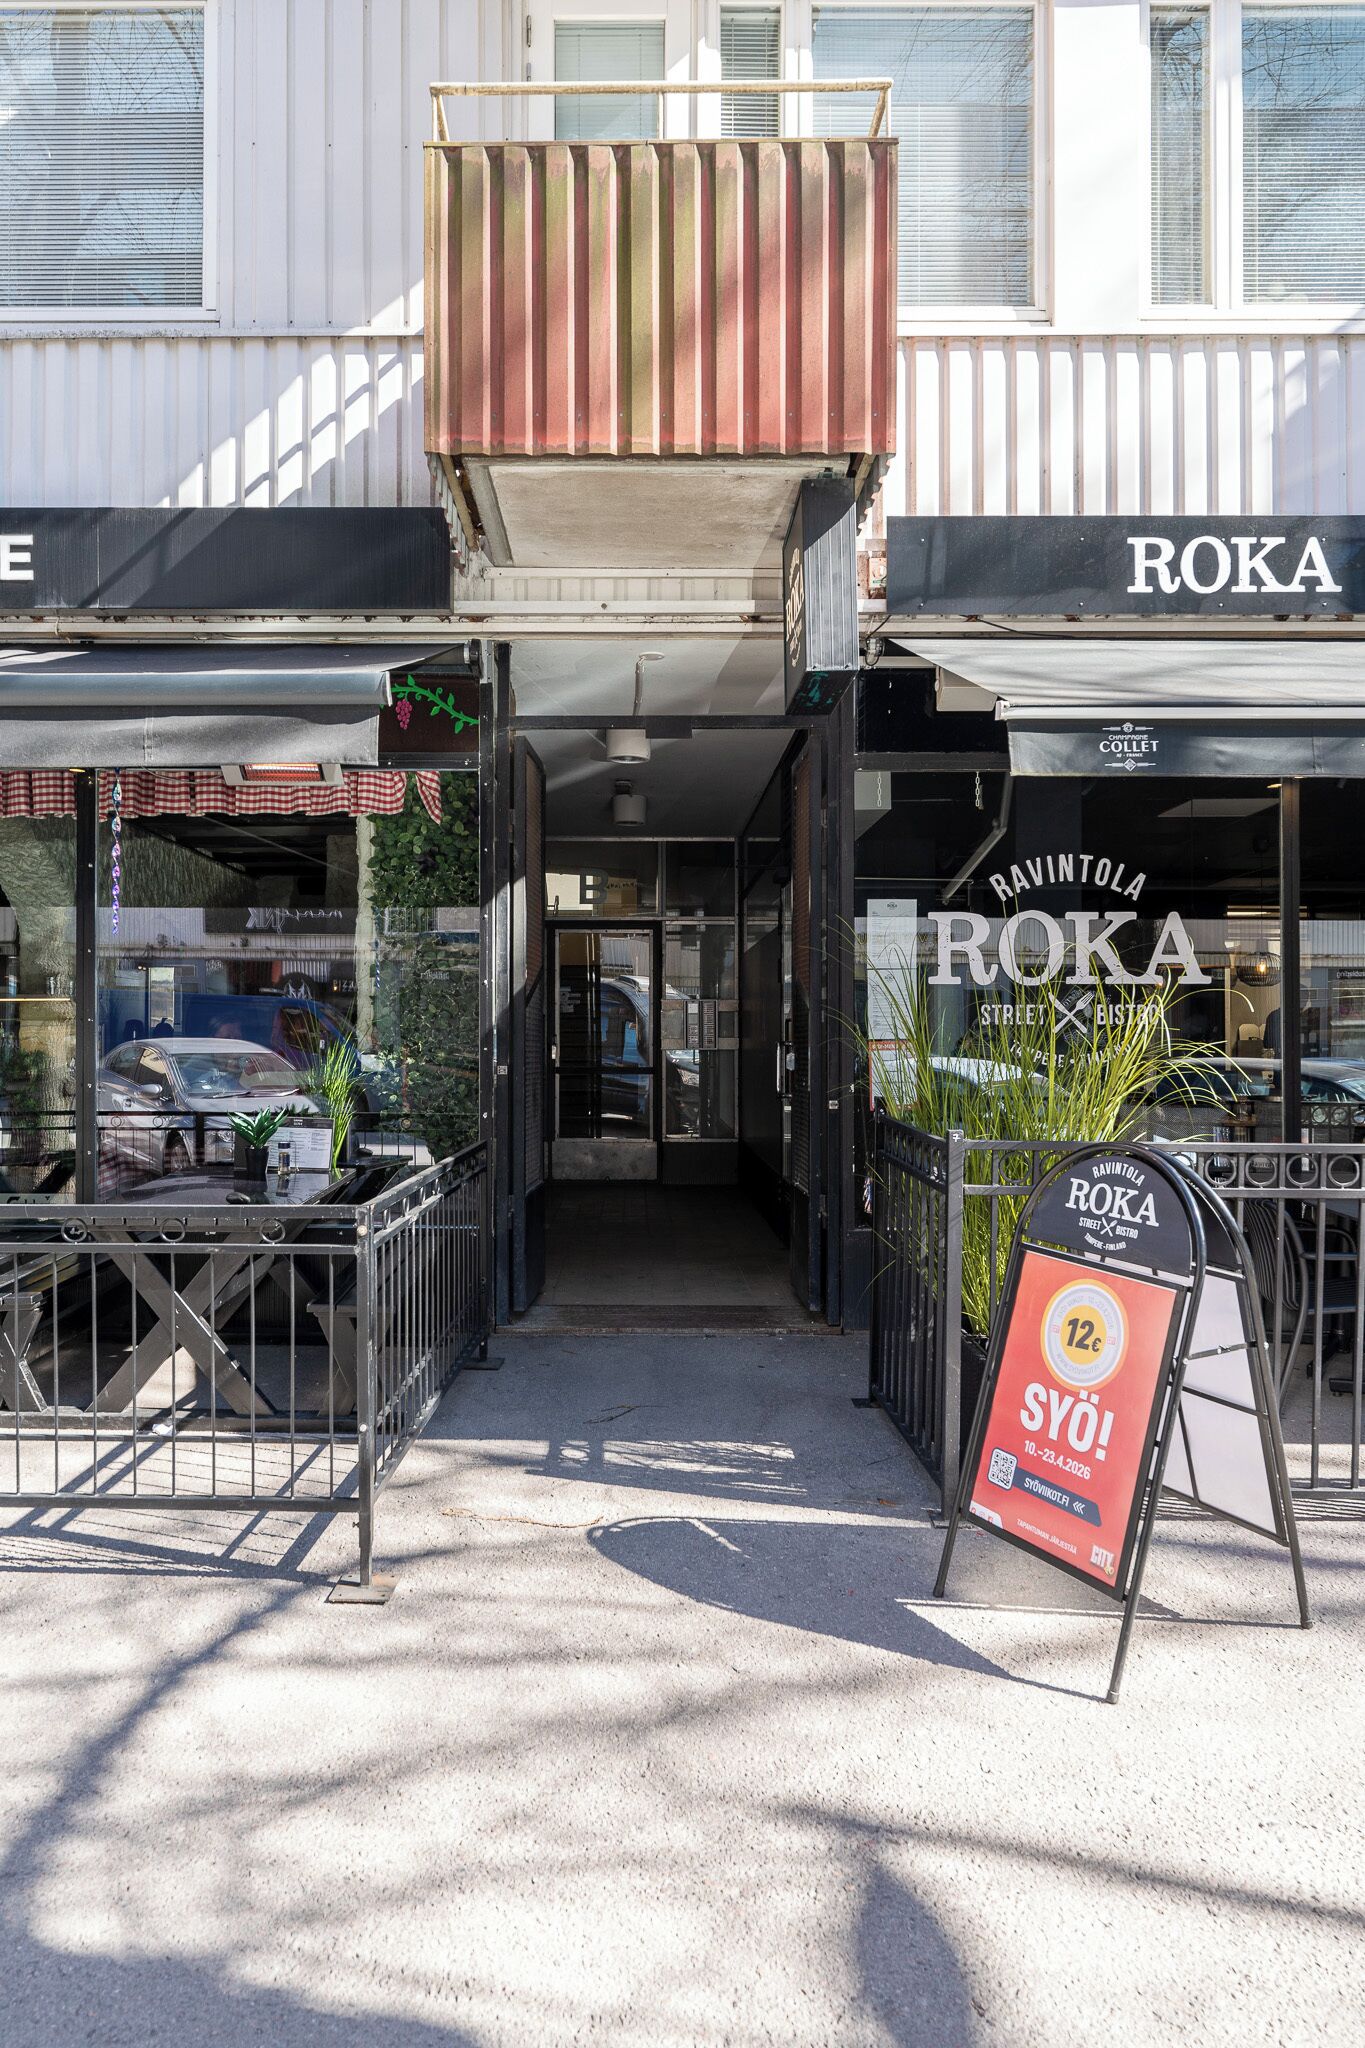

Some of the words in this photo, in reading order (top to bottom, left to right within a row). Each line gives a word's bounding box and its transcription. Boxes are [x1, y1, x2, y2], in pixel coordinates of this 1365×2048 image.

[1127, 535, 1343, 594] ROKA
[1099, 740, 1160, 753] COLLET
[579, 867, 609, 904] B
[989, 853, 1147, 902] RAVINTOLA
[927, 909, 1213, 987] ROKA
[980, 1003, 1048, 1026] STREET
[1092, 1161, 1146, 1187] RAVINTOLA
[1065, 1177, 1160, 1227] ROKA
[1078, 1216, 1102, 1231] STREET
[1115, 1225, 1139, 1239] BISTRO
[1020, 1382, 1115, 1462] SYÖ!
[1024, 1477, 1070, 1507] SYÖVIIKOT.FI
[1091, 1544, 1115, 1568] CITY
